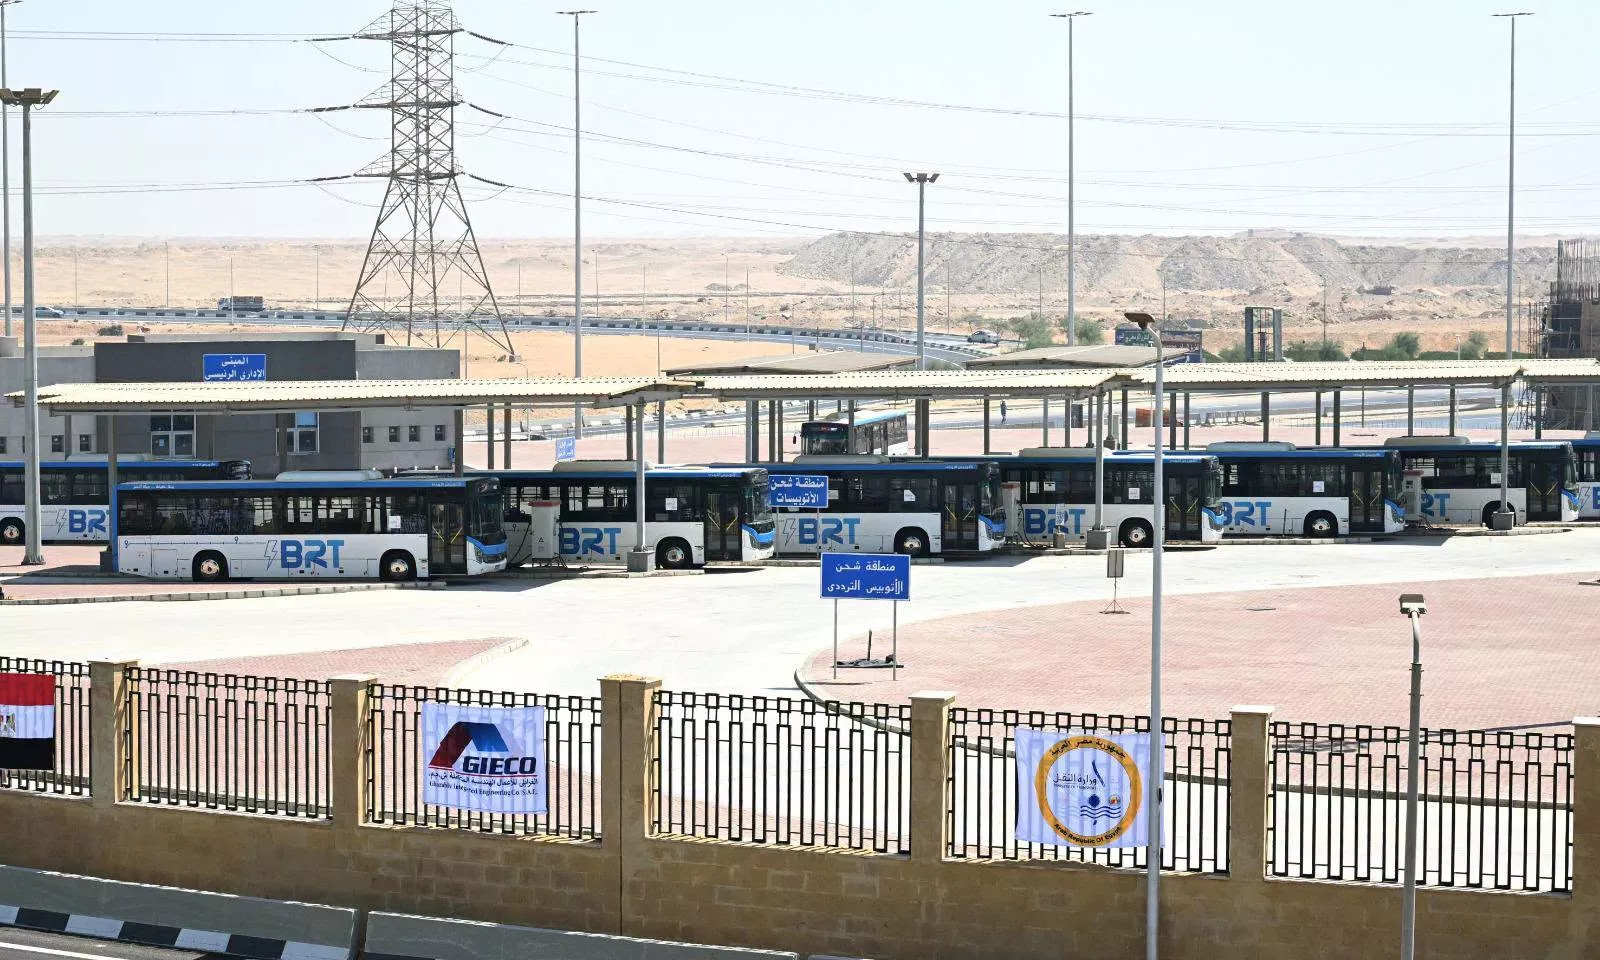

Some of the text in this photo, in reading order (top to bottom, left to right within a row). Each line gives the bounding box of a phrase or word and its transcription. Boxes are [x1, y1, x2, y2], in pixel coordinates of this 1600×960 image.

[222, 357, 249, 367] المبنى
[771, 477, 824, 490] منطقة شحن
[1421, 494, 1450, 517] RT
[69, 510, 110, 533] BR
[799, 518, 860, 545] BRT
[559, 528, 621, 555] BRT
[281, 540, 344, 569] BRT
[835, 560, 896, 573] منطقة شحن
[865, 578, 903, 594] الأتوبيس
[1076, 739, 1093, 747] مصر
[463, 756, 537, 775] GIECO
[1053, 772, 1076, 784] النقل
[1054, 824, 1068, 836] Arab
[1068, 834, 1095, 844] Republic
[1104, 826, 1121, 840] Egypt
